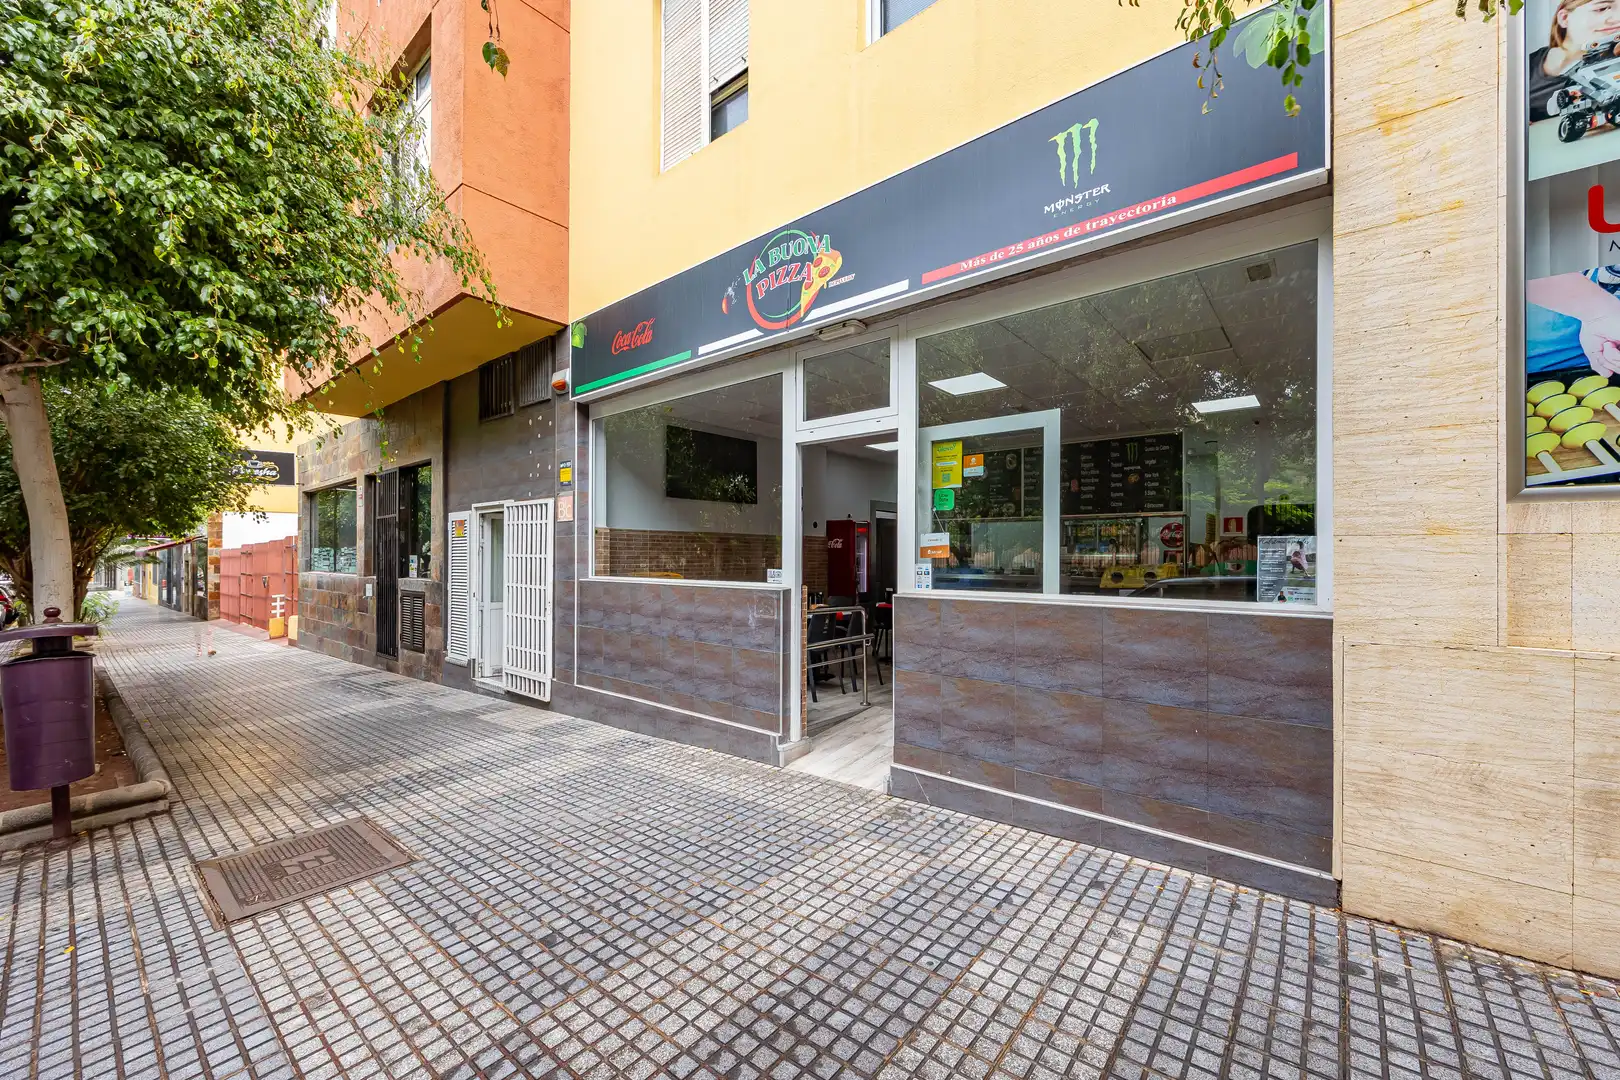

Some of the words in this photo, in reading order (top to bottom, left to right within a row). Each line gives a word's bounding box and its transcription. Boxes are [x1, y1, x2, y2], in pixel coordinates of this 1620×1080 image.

[1053, 198, 1100, 218] ENERGY
[960, 257, 986, 271] Más
[989, 250, 1005, 262] de
[1008, 243, 1023, 256] 25
[1027, 233, 1060, 249] años
[1063, 225, 1081, 238] de
[1085, 194, 1177, 231] trayectoria
[742, 258, 767, 286] LA
[768, 234, 831, 267] BUONA
[755, 261, 813, 300] PIZZA
